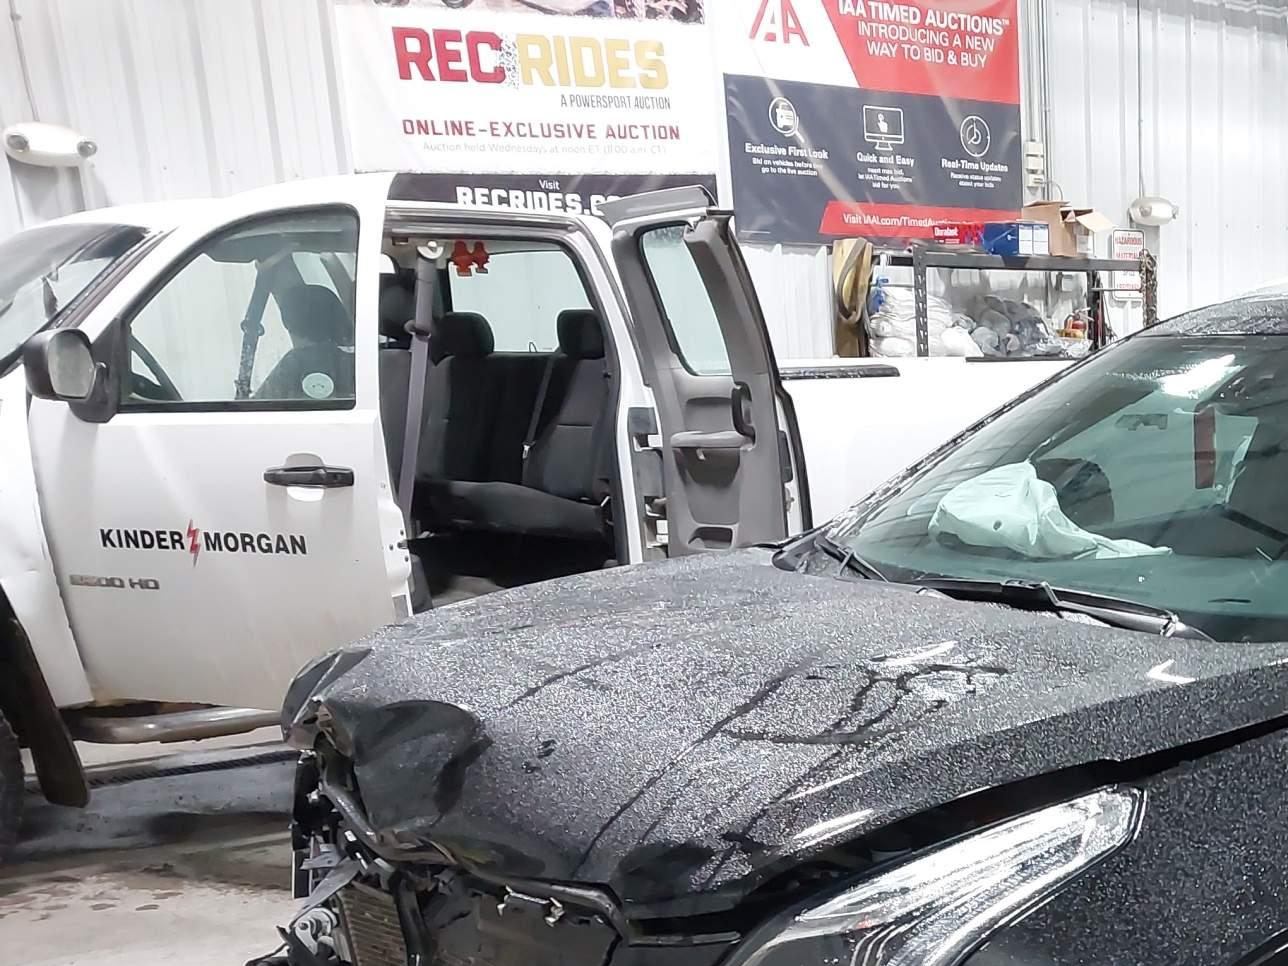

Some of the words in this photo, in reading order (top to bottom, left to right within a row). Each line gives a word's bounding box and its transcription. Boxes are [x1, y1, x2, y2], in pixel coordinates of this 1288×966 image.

[868, 1, 920, 25] TIMED
[858, 21, 949, 45] INTRODUCING
[952, 36, 962, 48] A
[966, 36, 995, 52] NEW
[867, 40, 899, 57] WAY
[901, 43, 920, 59] TO
[923, 47, 944, 64] BID
[947, 51, 958, 65] &
[960, 51, 987, 68] BUY
[561, 94, 568, 107] A
[569, 94, 631, 109] POWERSPORT
[634, 96, 671, 110] AUCTION
[402, 119, 597, 139] ONLINE-EXCLUSIVE
[605, 123, 680, 140] AUCTION
[423, 141, 461, 153] Auction
[745, 142, 787, 156] Exclusive
[788, 146, 808, 157] First
[808, 148, 829, 160] Look
[856, 151, 878, 164] Quick
[878, 155, 894, 165] and
[896, 155, 915, 167] Easy
[941, 158, 979, 170] Real-Time
[980, 160, 1009, 172] Updates
[539, 179, 560, 190] Visit
[843, 213, 863, 224] Visit
[100, 528, 185, 551] KINDER
[203, 531, 308, 555] MORGAN
[129, 577, 160, 590] HD
